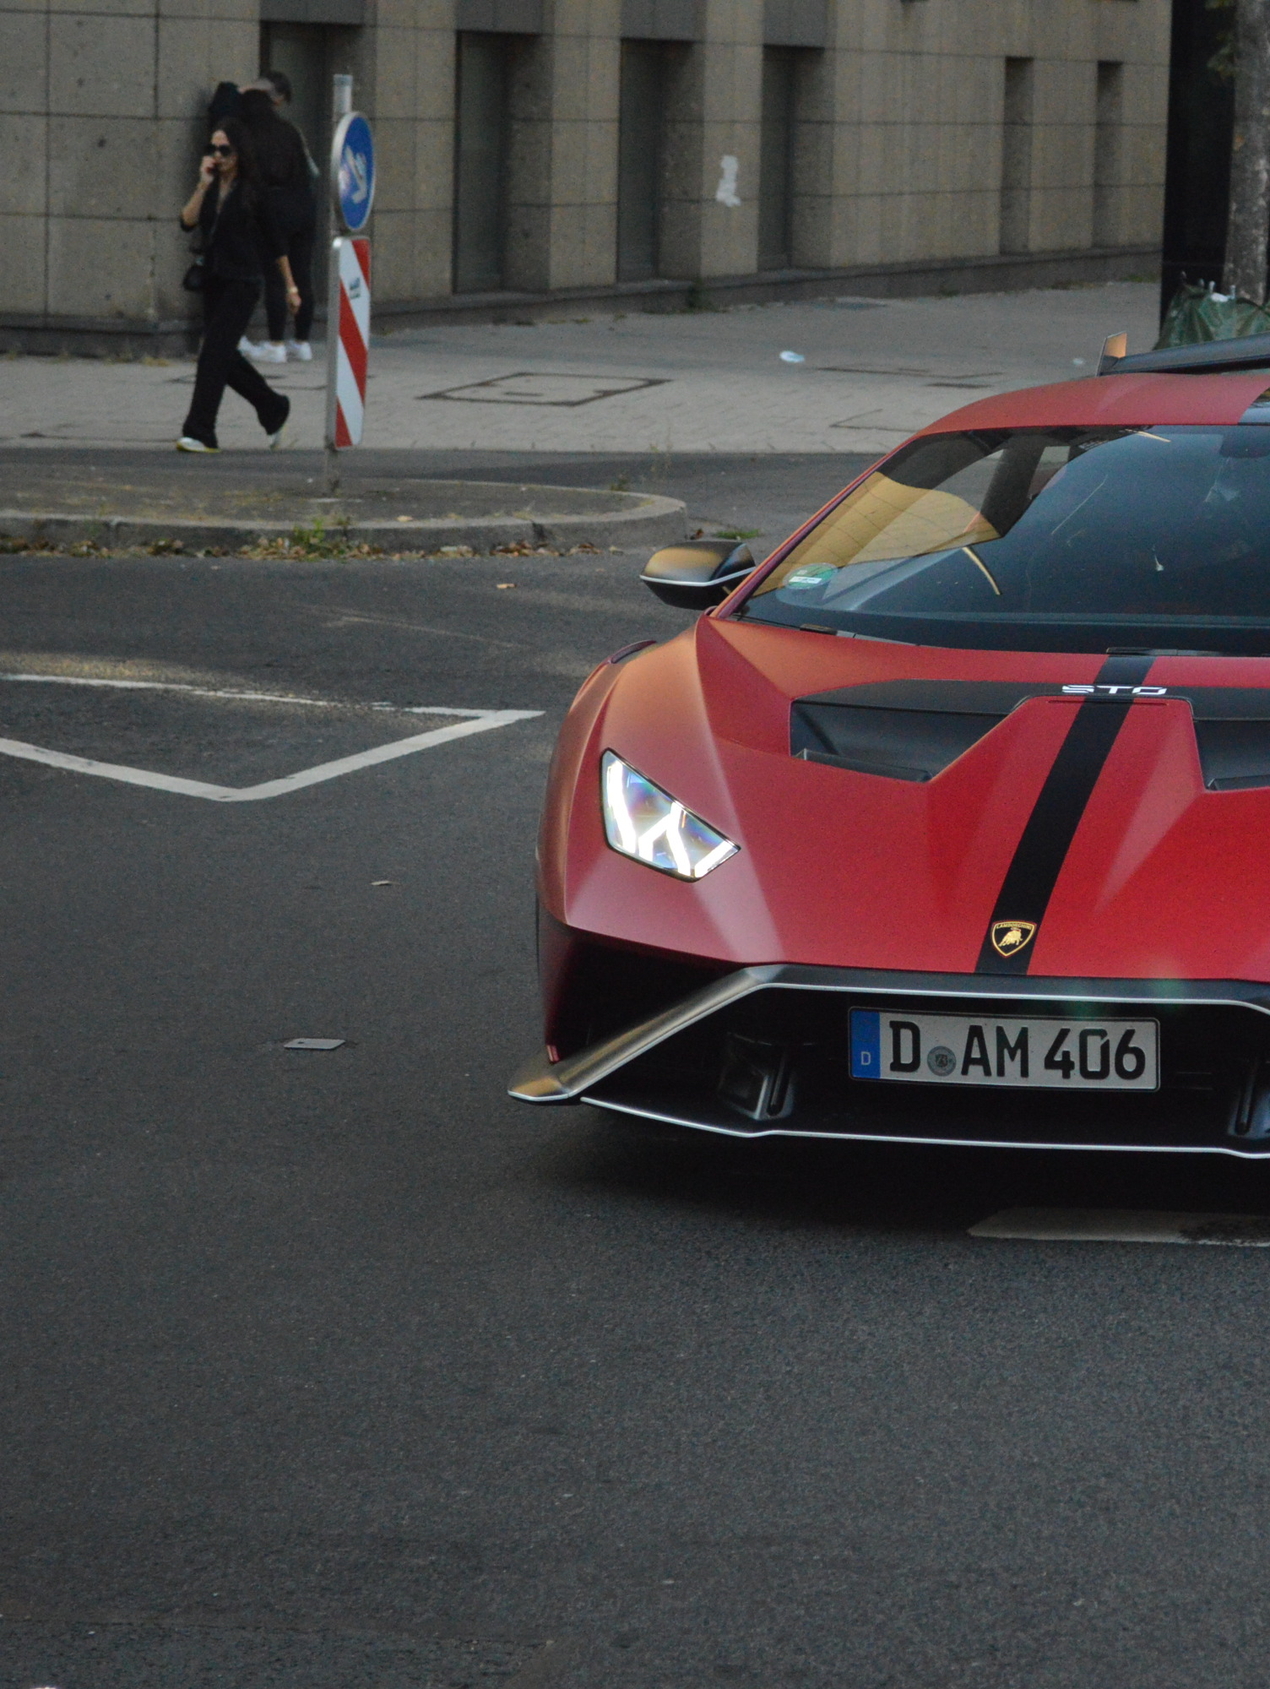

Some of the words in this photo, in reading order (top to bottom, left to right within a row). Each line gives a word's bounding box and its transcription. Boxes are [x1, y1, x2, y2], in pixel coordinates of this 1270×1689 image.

[1062, 684, 1168, 695] STO
[889, 1020, 921, 1073] D
[961, 1025, 1029, 1078] AM
[1044, 1028, 1147, 1080] 406
[861, 1051, 872, 1066] D
